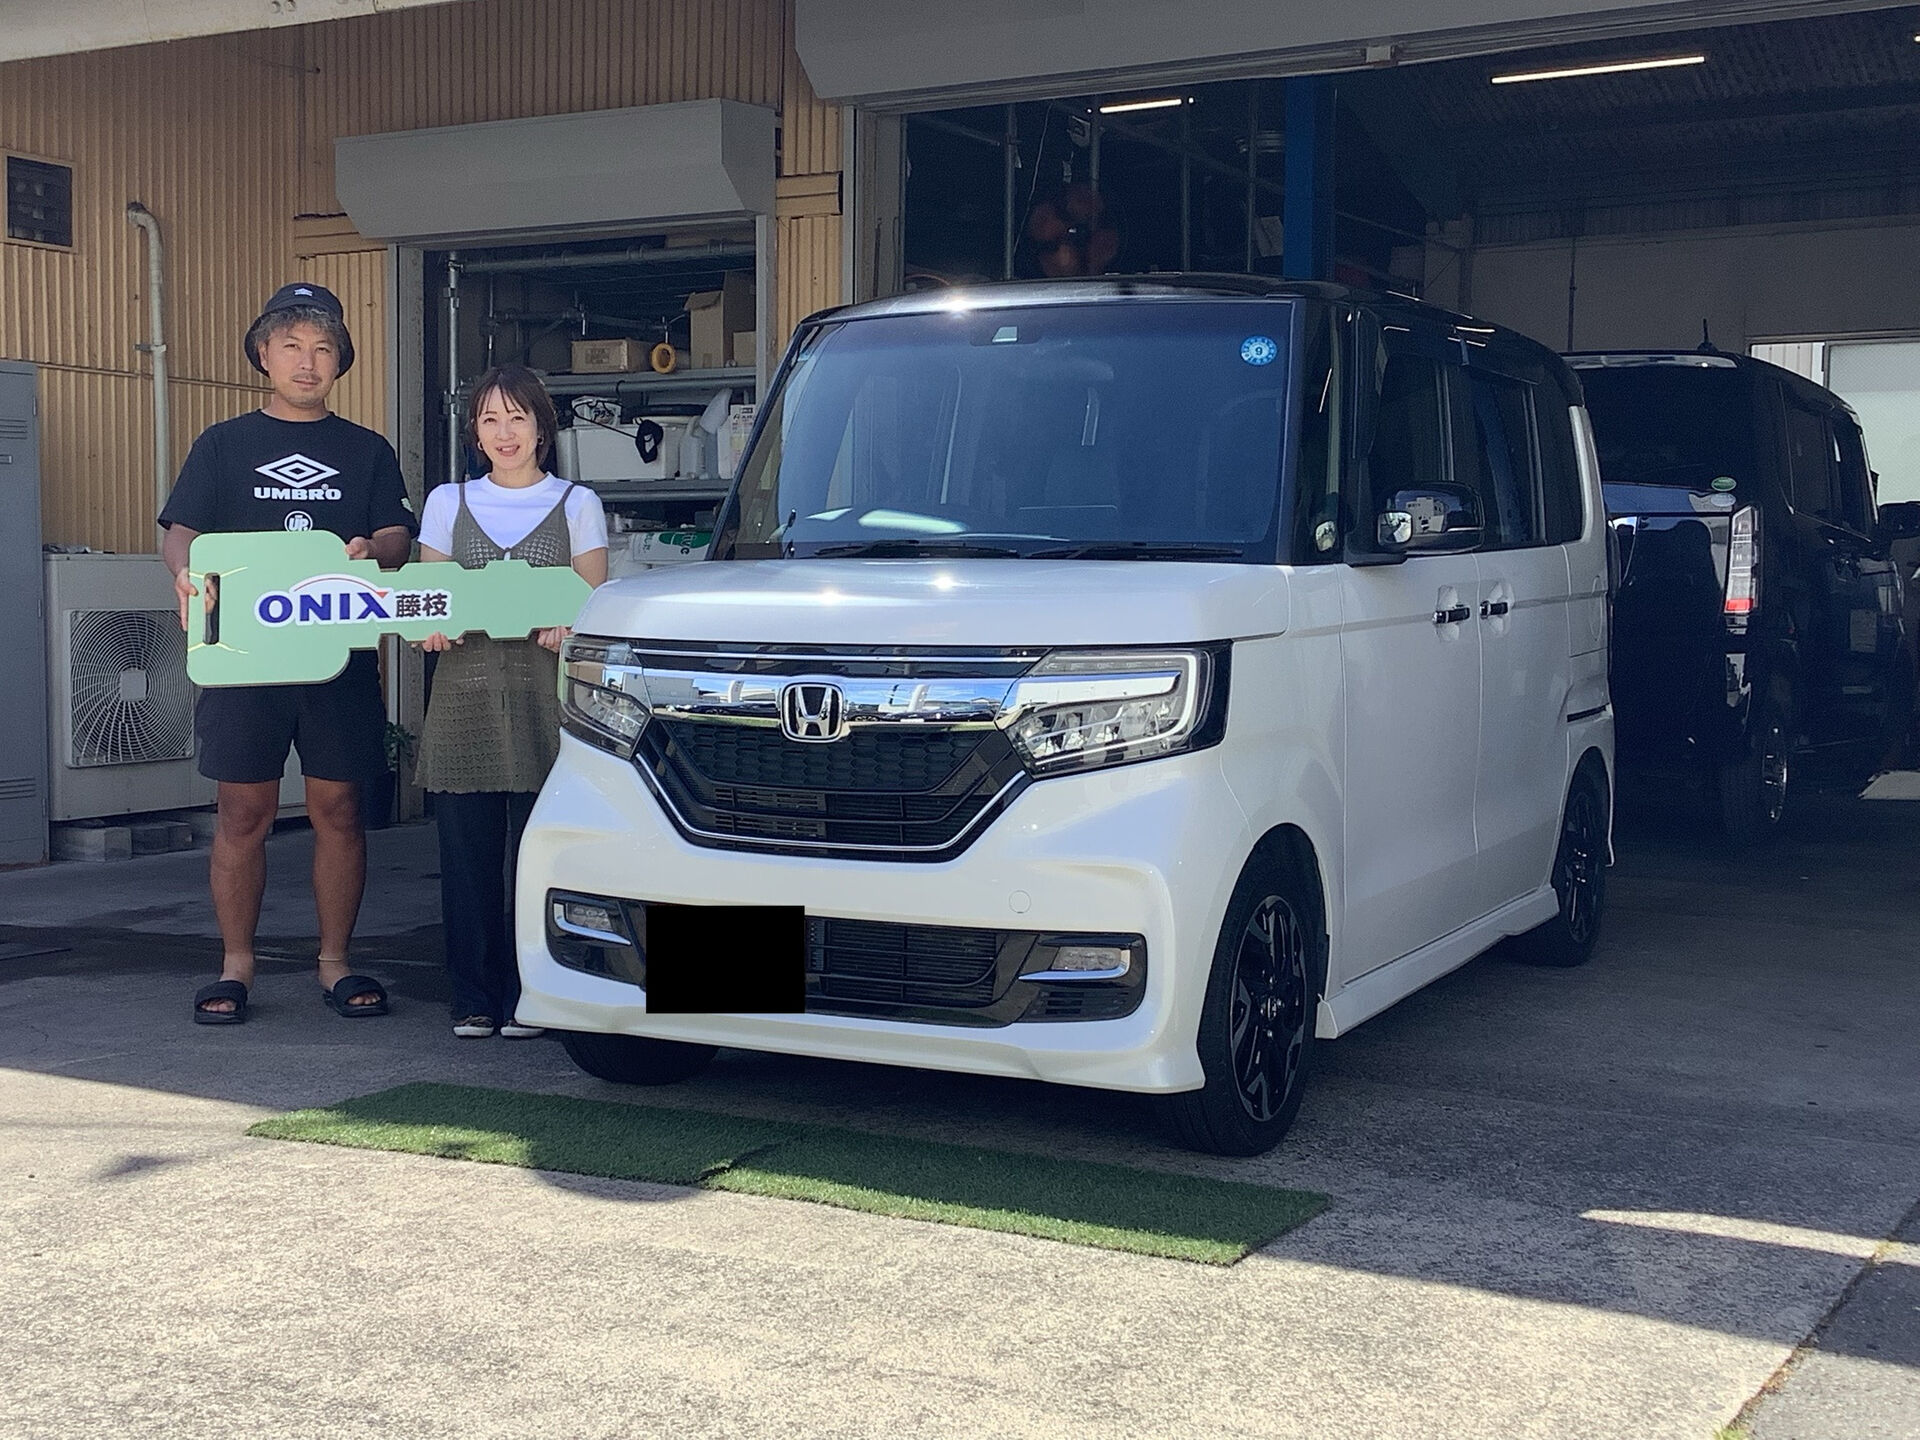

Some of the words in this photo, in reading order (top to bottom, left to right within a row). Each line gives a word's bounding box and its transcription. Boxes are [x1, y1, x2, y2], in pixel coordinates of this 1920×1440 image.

[253, 486, 342, 500] UMBRO
[258, 592, 391, 624] ONIX
[395, 592, 448, 618] 藤枝
